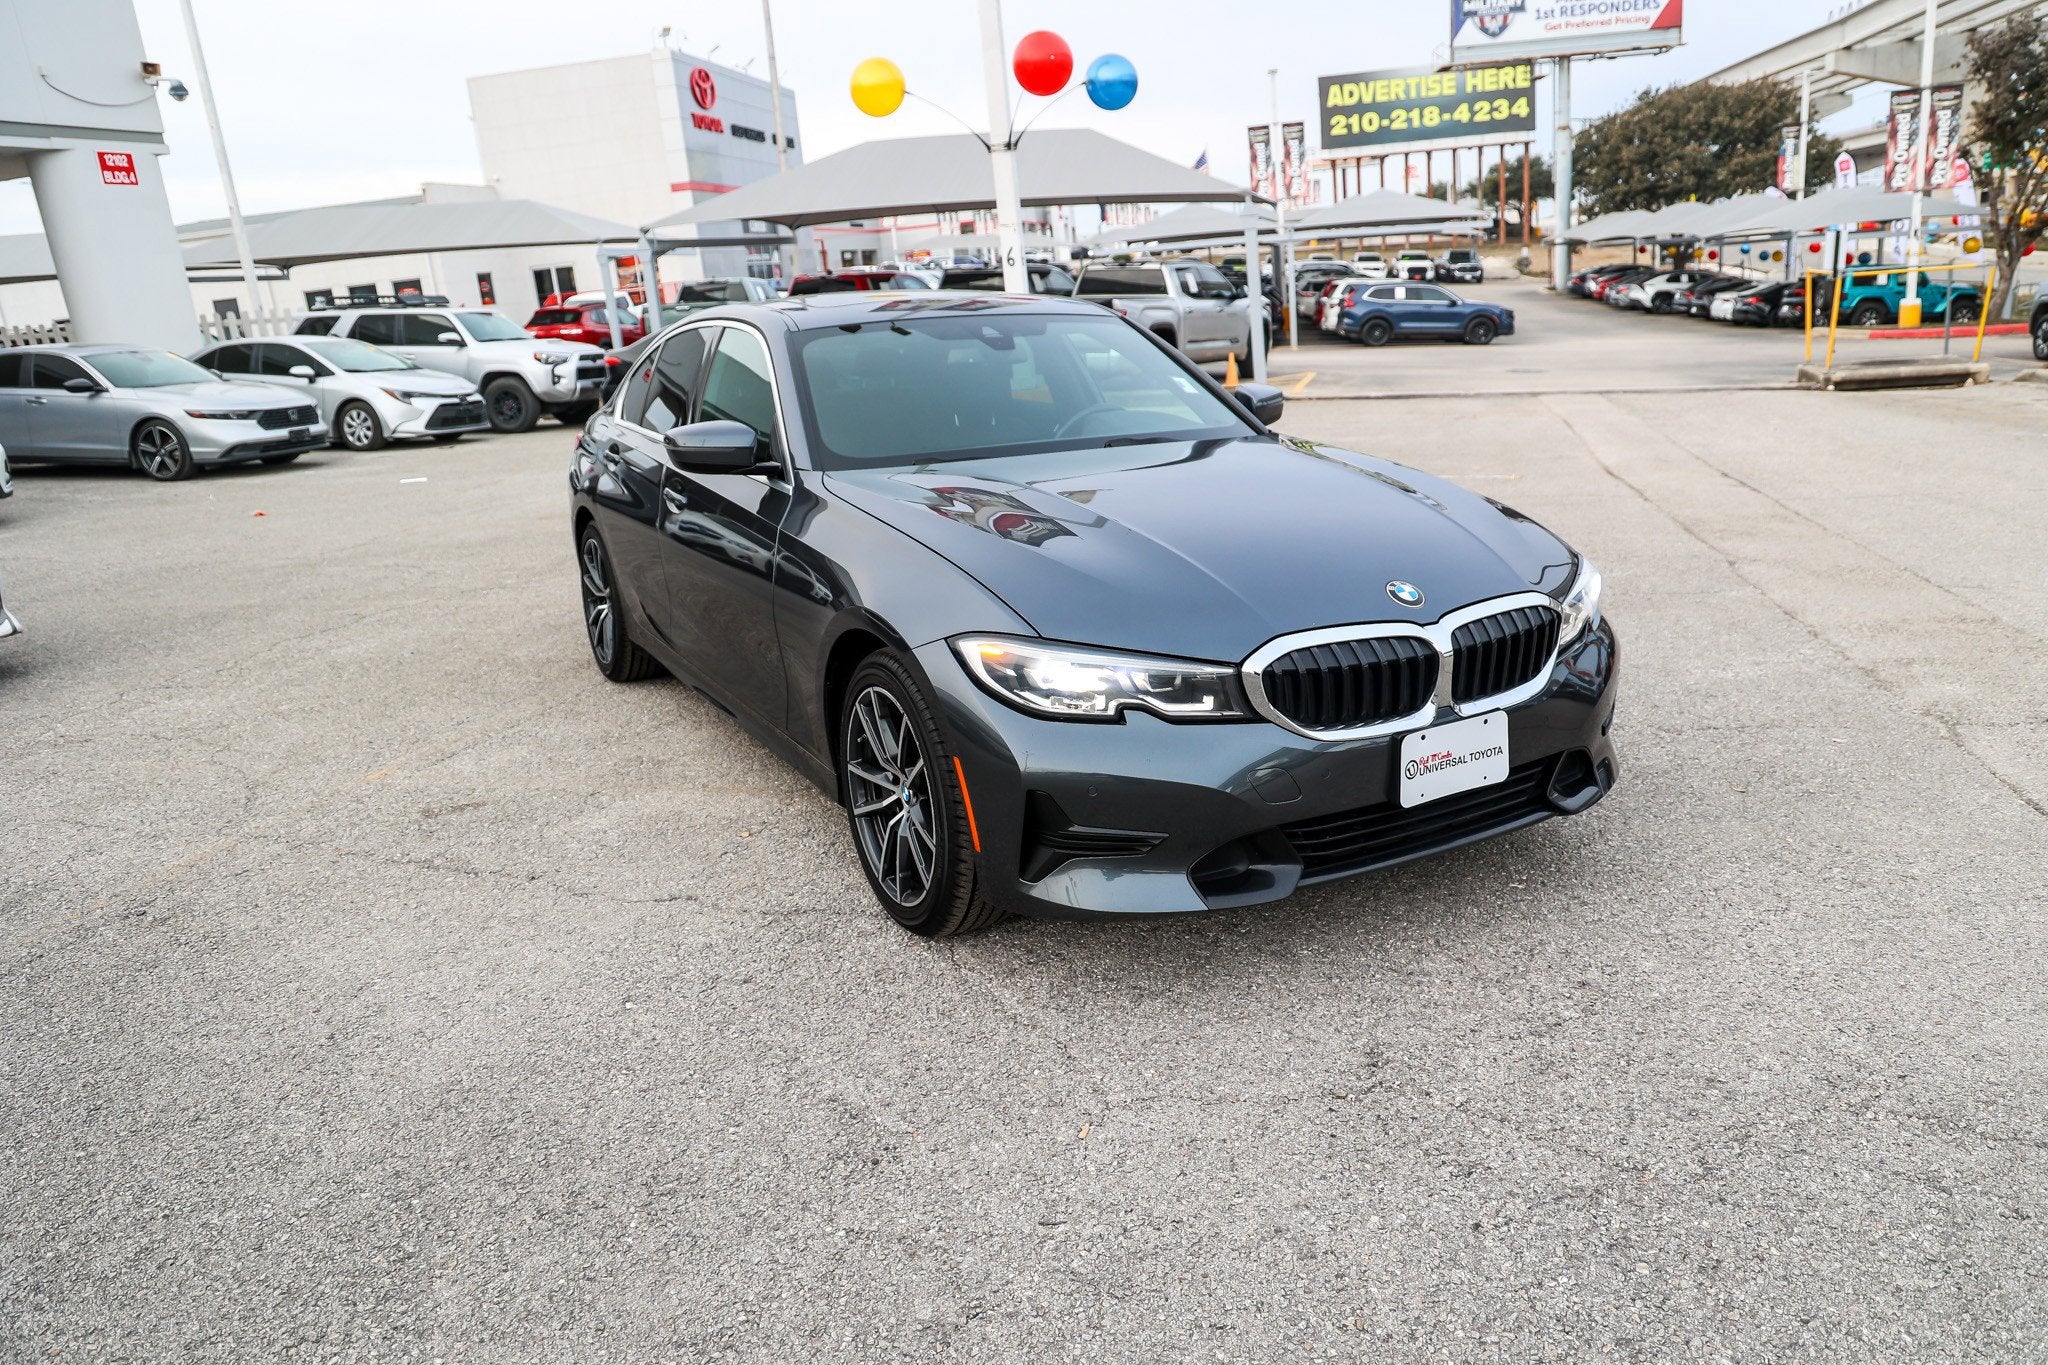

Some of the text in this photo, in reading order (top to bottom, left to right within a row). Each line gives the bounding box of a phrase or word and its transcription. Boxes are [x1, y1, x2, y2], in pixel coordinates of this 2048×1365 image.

[1536, 0, 1660, 19] 1st RESPONDERS
[1545, 16, 1650, 30] Get Preferred Pricing
[1327, 65, 1531, 108] ADVERTISE HERE
[1329, 97, 1530, 136] 210-218-4234
[1893, 113, 1911, 162] Owned
[1933, 109, 1952, 159] Owned
[1891, 163, 1909, 190] Pre
[1931, 160, 1949, 185] Pre
[1007, 246, 1015, 266] 6
[1419, 746, 1504, 776] UNIVERSAL TOYOTA
